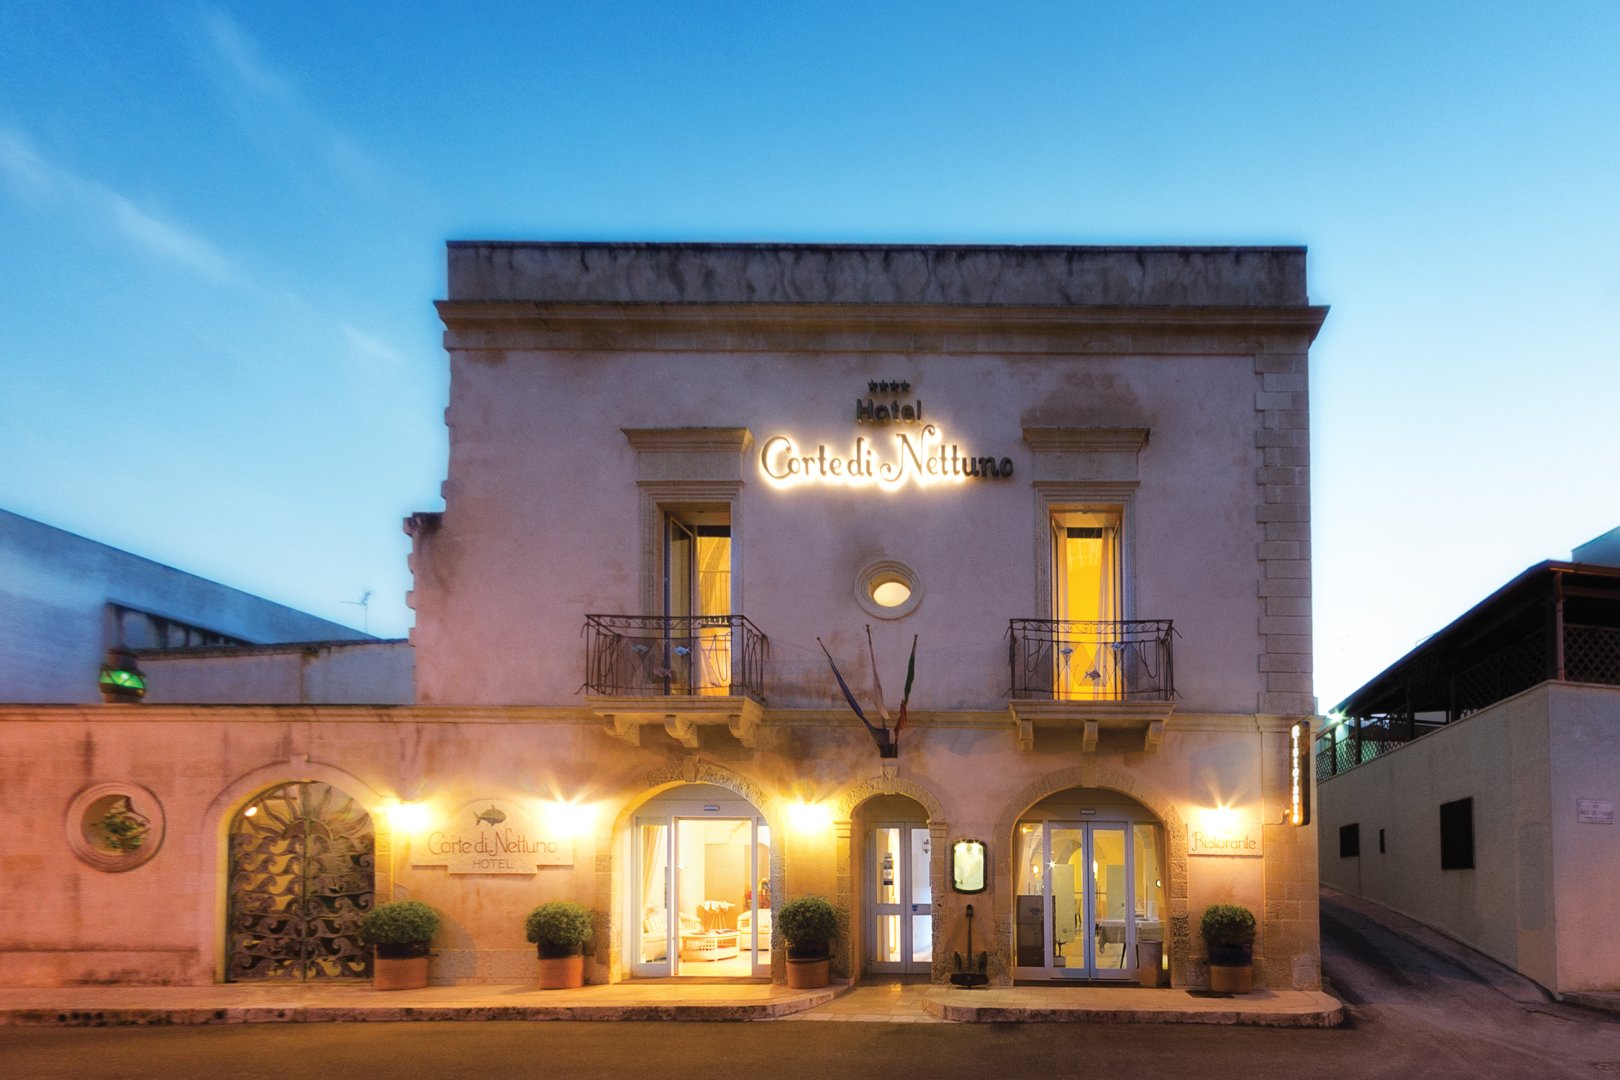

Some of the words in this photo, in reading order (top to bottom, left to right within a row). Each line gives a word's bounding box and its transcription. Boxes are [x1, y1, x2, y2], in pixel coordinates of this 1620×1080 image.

[855, 399, 921, 421] Hotel
[761, 436, 842, 480] Corte
[847, 437, 873, 477] di
[879, 424, 1014, 482] Nettuno
[427, 832, 472, 856] Corte
[474, 831, 488, 854] di
[489, 828, 558, 857] Nettuno
[1191, 831, 1257, 852] Ristorante
[472, 858, 513, 869] HOTEL
